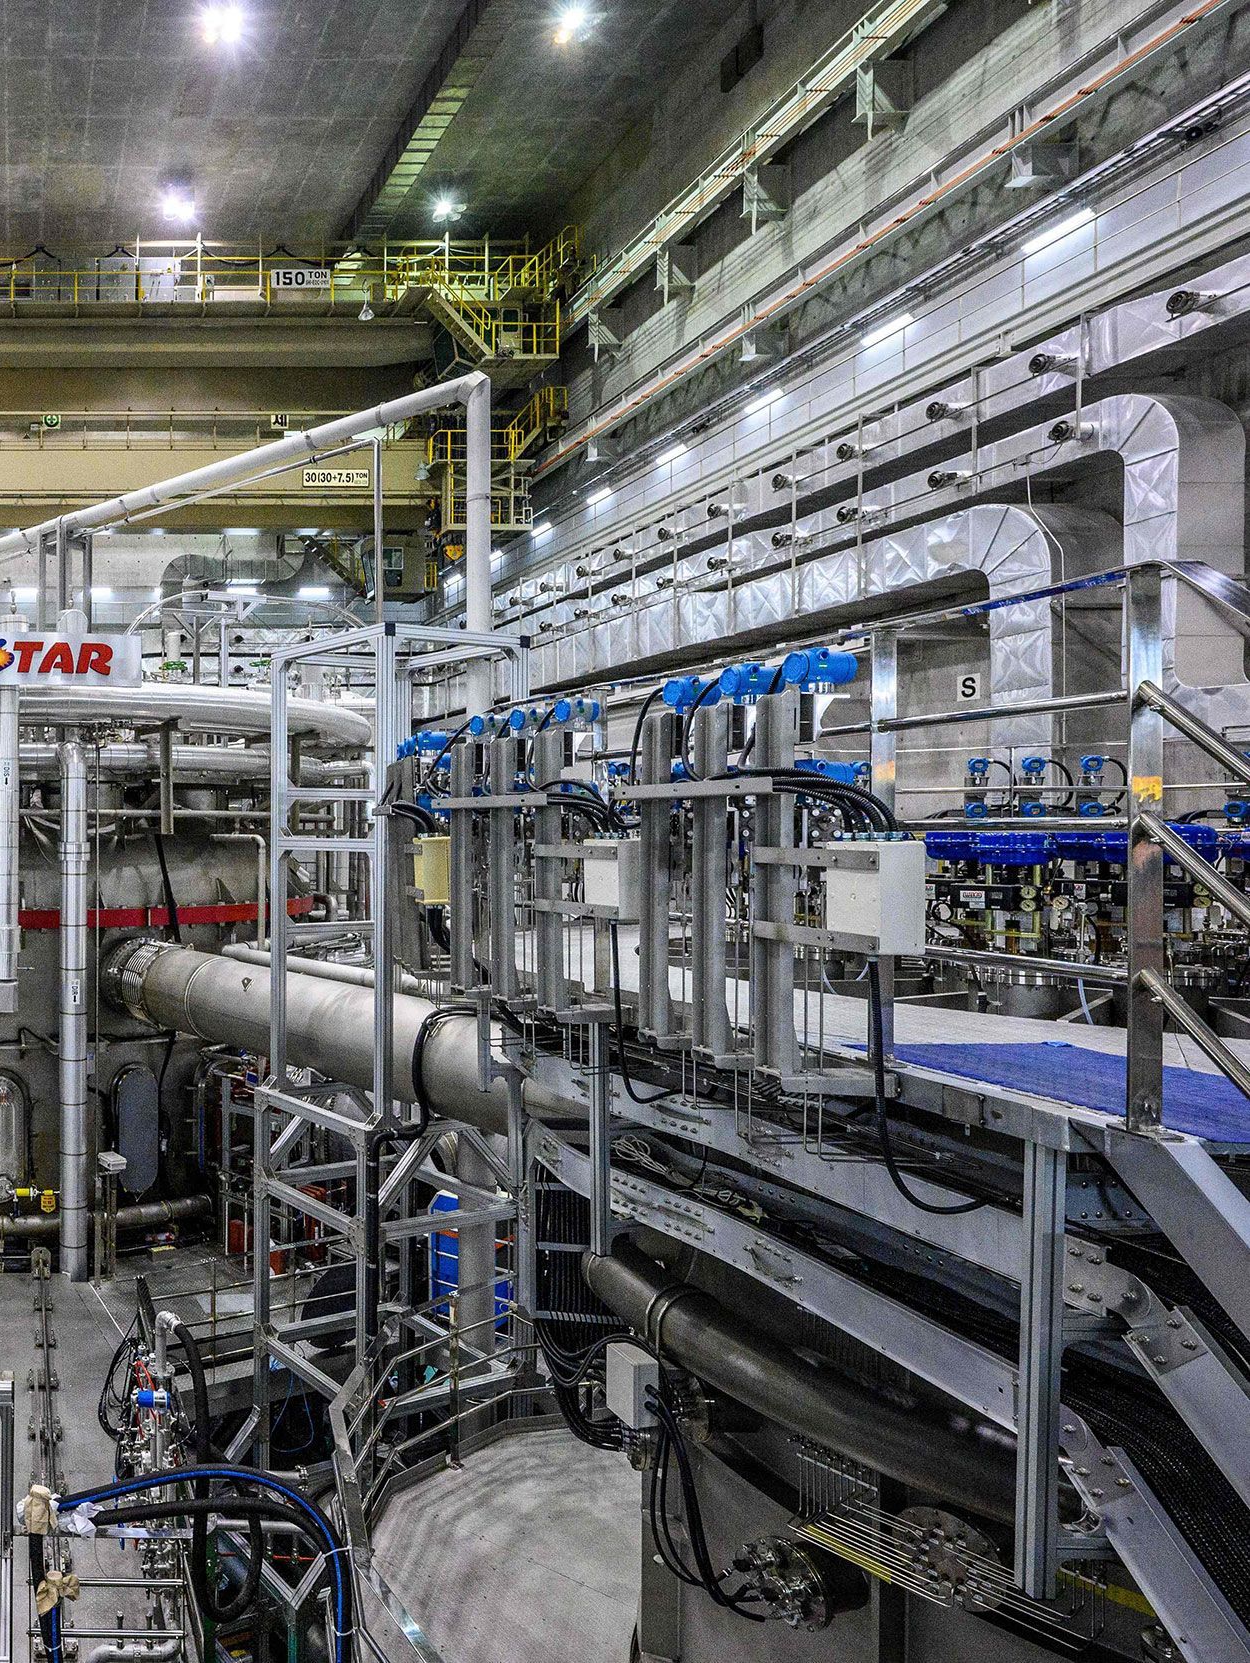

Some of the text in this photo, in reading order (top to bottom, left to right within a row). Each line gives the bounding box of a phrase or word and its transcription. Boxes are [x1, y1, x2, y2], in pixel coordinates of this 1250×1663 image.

[275, 271, 305, 286] 150
[308, 271, 327, 279] TON
[305, 472, 355, 483] 30(30+7.5)
[961, 676, 976, 698] S
